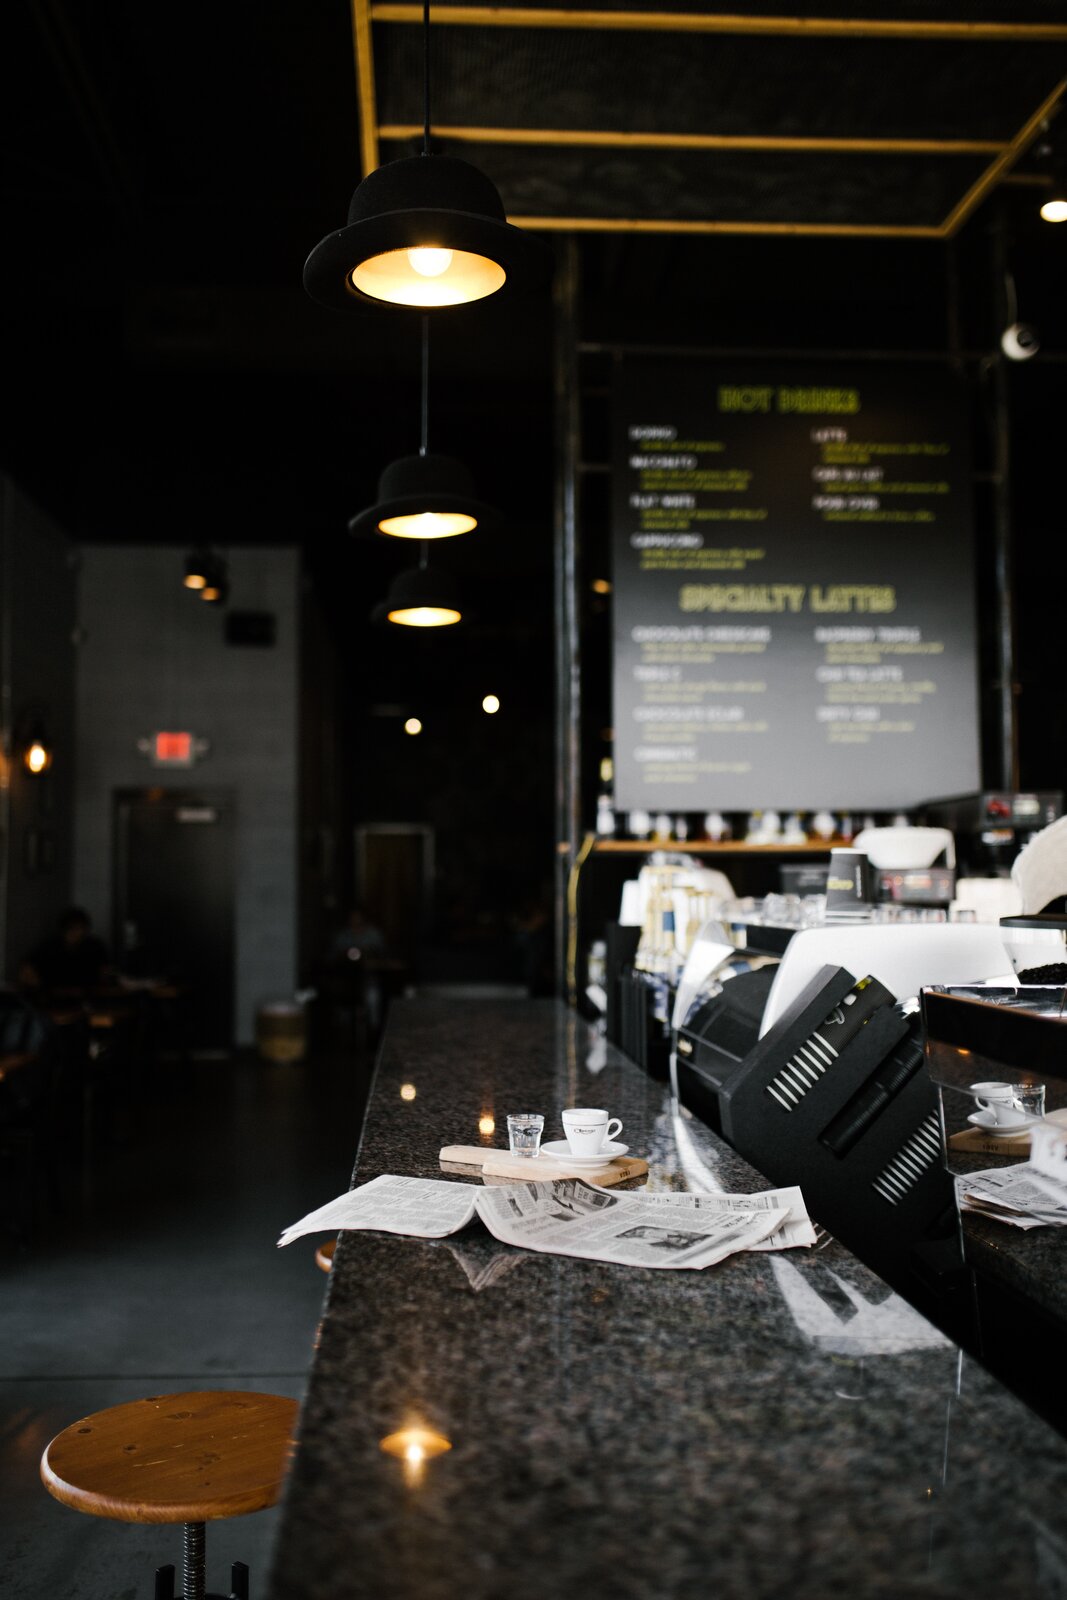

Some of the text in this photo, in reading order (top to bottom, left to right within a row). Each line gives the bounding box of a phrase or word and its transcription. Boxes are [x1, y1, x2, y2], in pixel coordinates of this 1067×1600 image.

[718, 386, 860, 414] HOT DRINKS
[679, 583, 897, 613] SPECIALTY LATTES
